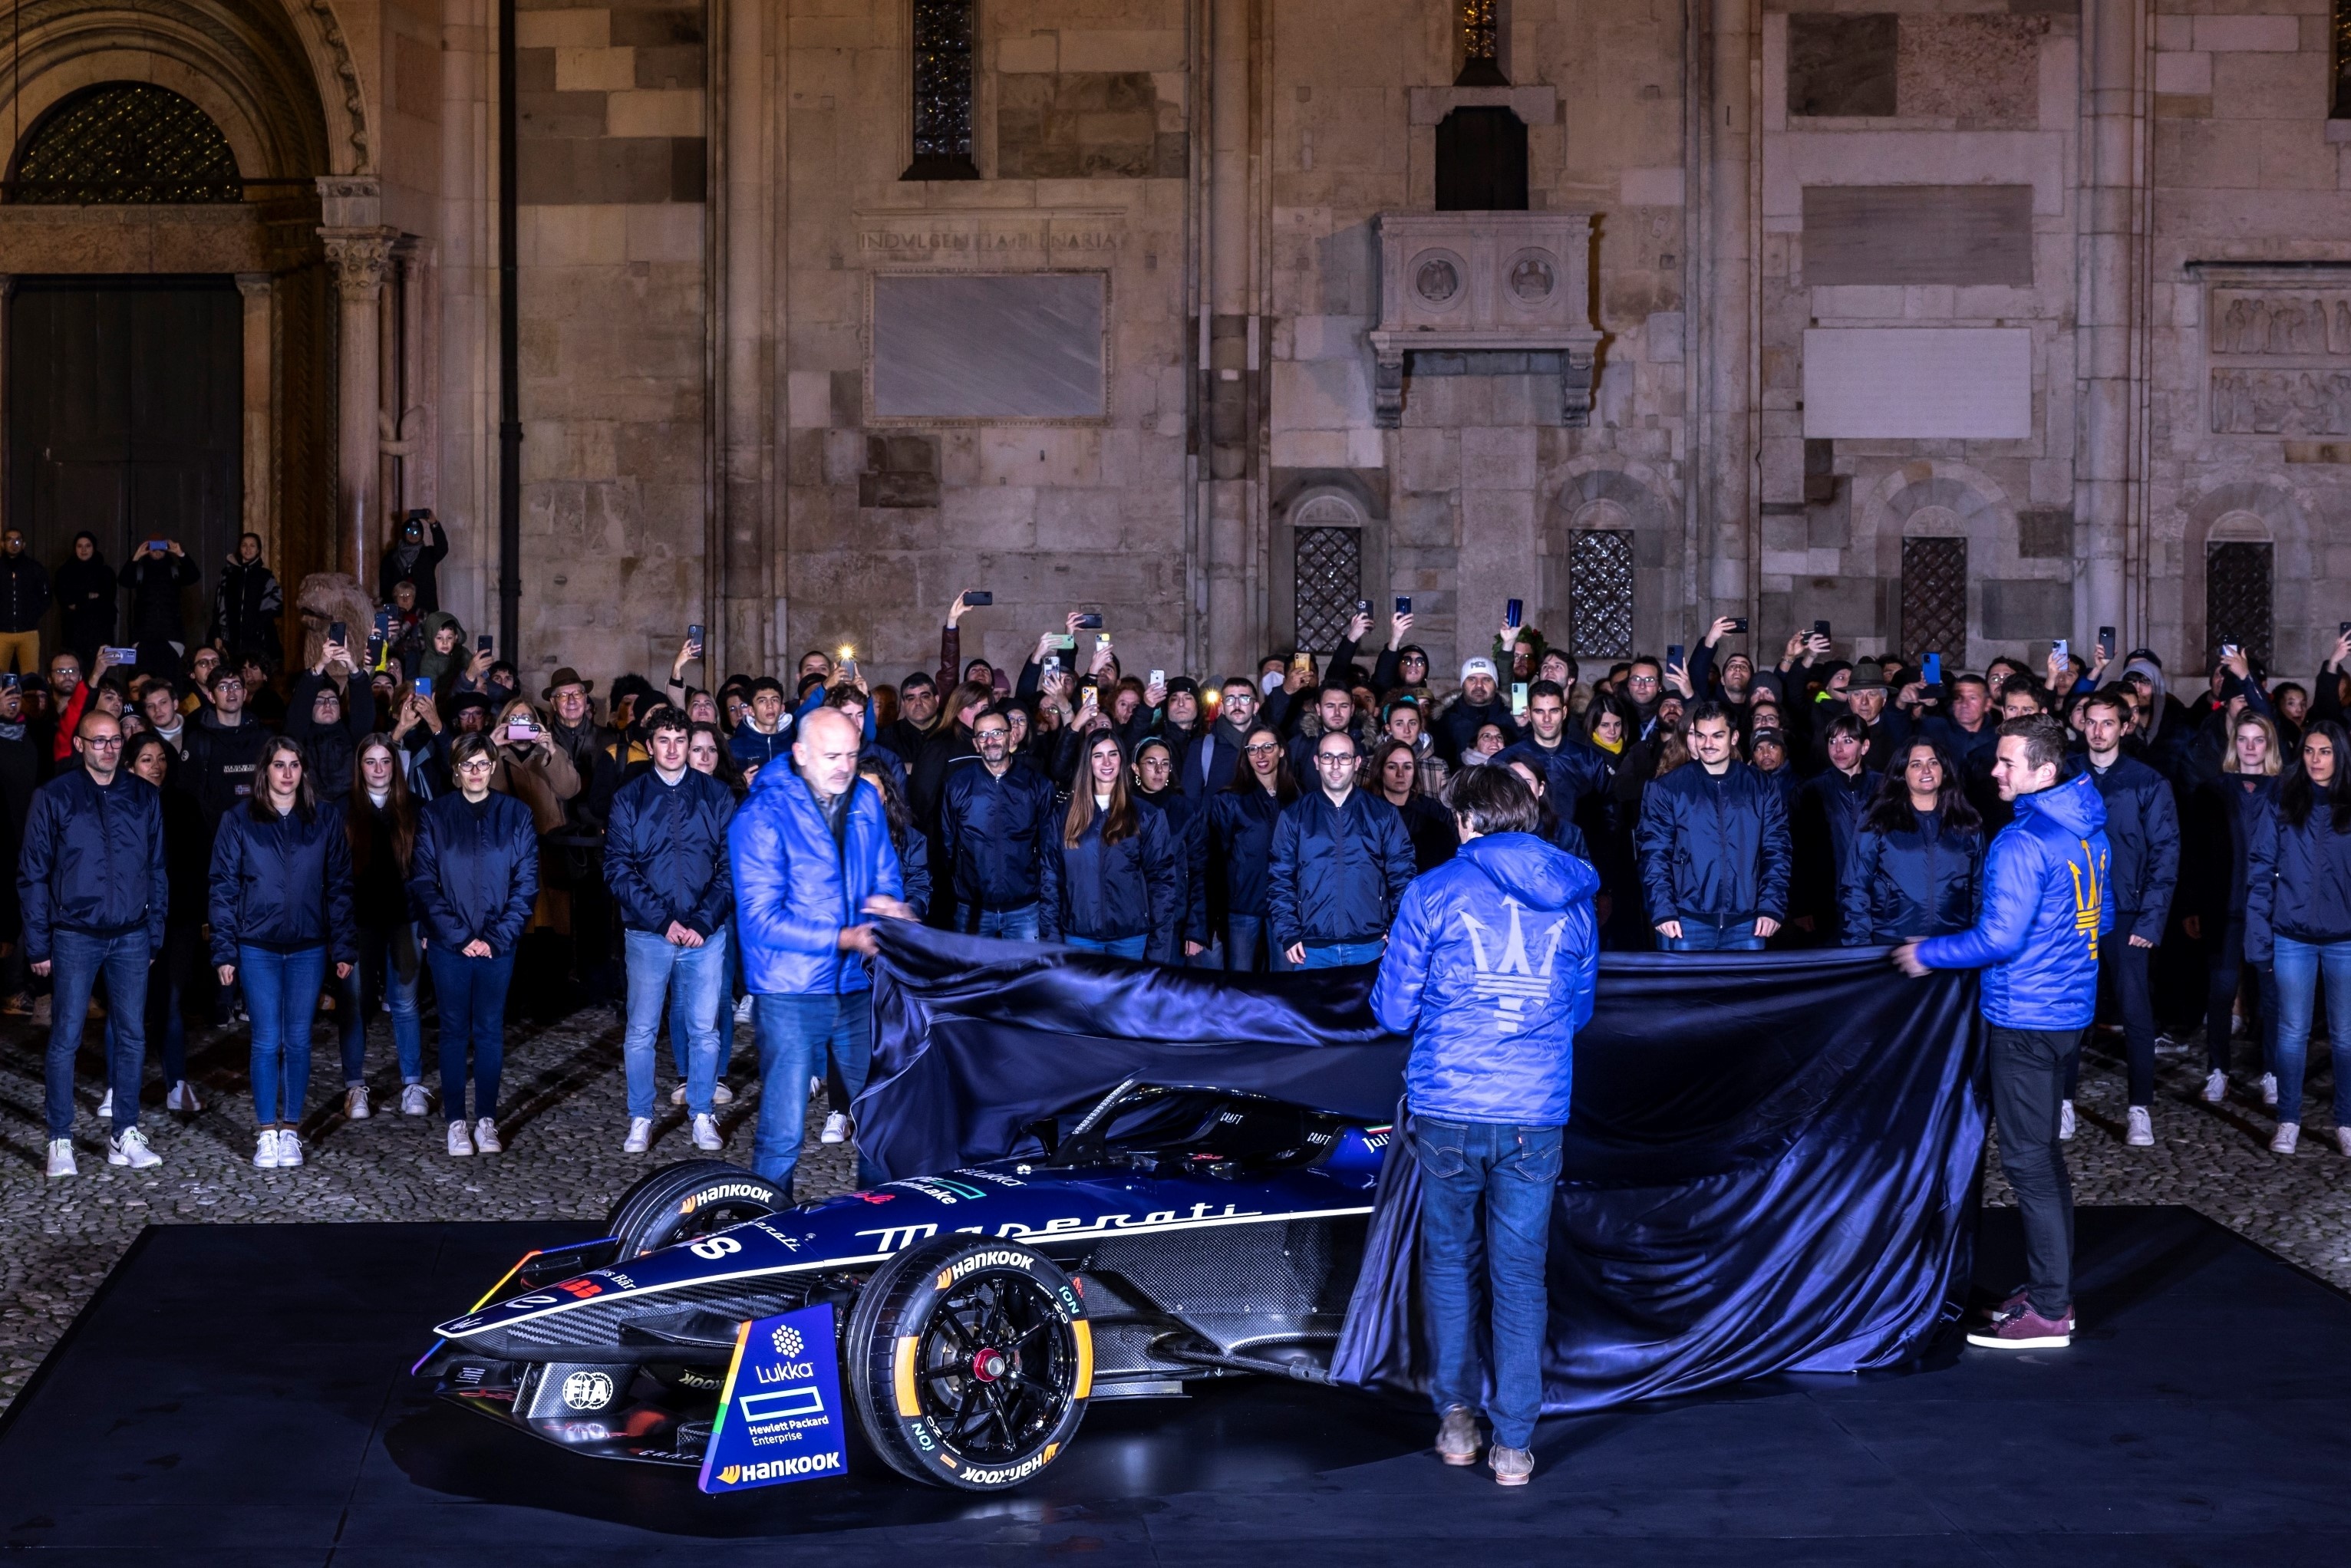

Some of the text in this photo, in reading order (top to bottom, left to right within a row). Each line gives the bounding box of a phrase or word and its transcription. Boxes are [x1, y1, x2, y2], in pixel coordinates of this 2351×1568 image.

[1220, 1112, 1244, 1125] CRAFT
[1307, 1132, 1332, 1145] CRAFT
[690, 1237, 742, 1260] 8
[556, 1279, 603, 1298] BB
[610, 1274, 637, 1290] Bär
[755, 1361, 813, 1384] Lukka
[748, 1415, 829, 1435] Hewlett Packard
[752, 1431, 803, 1447] Enterprise
